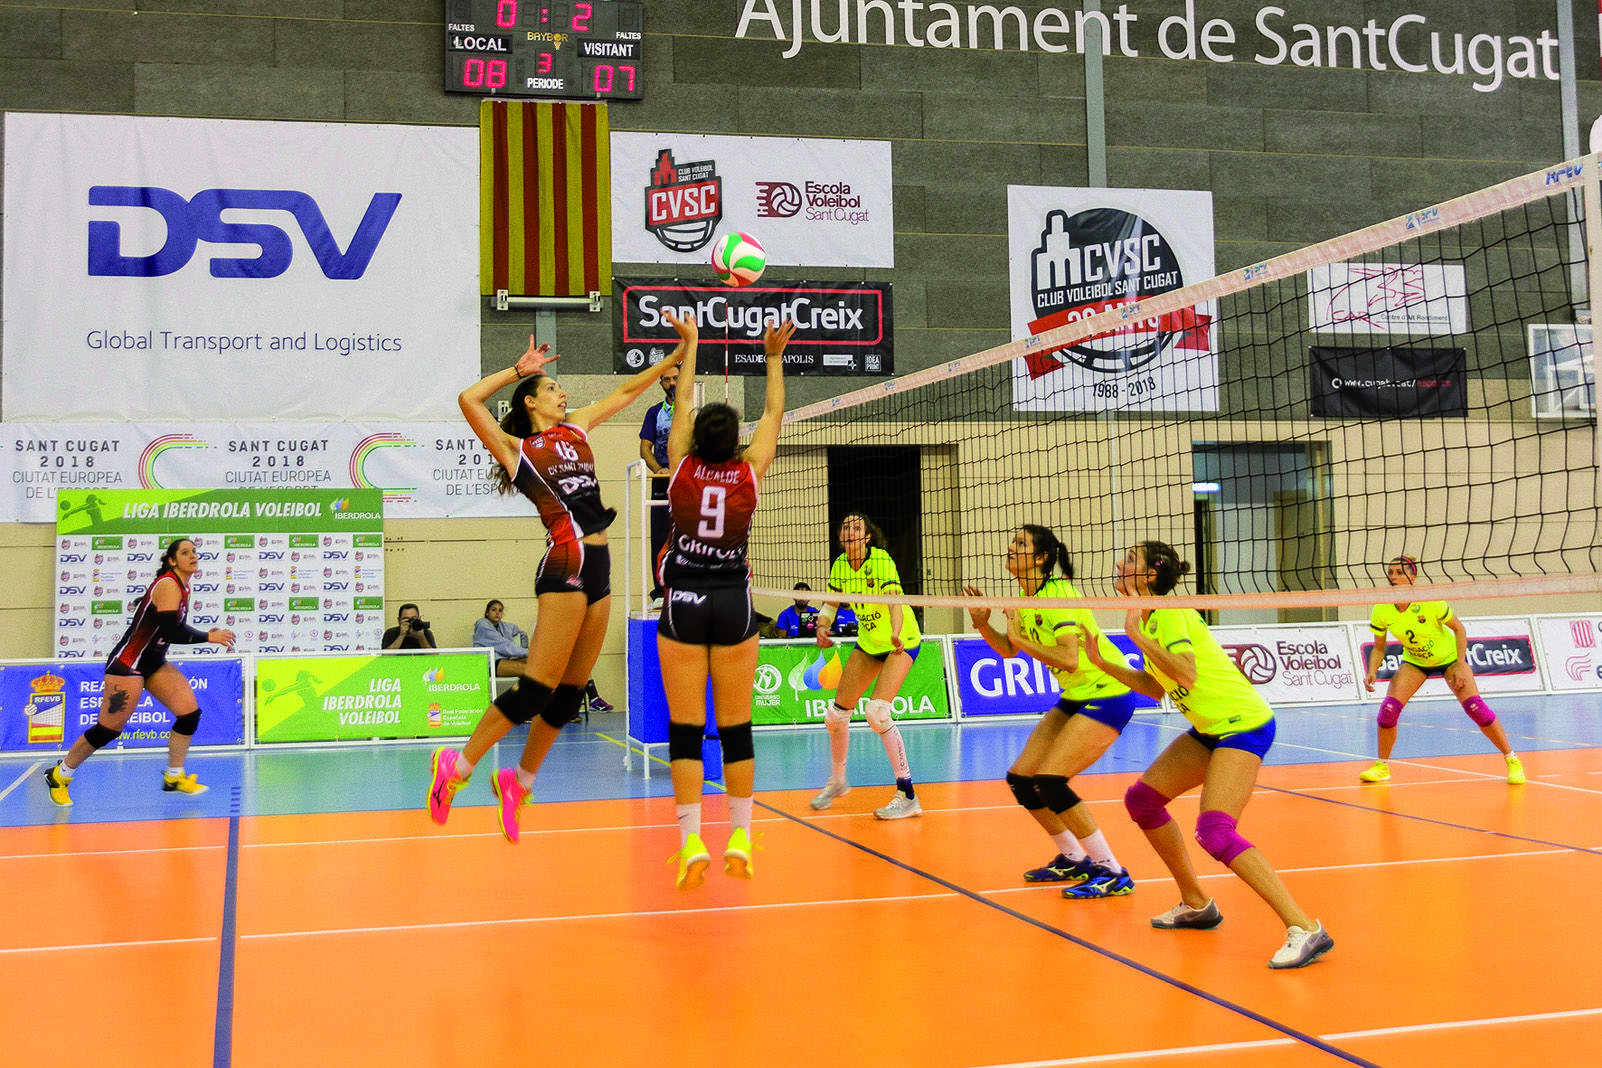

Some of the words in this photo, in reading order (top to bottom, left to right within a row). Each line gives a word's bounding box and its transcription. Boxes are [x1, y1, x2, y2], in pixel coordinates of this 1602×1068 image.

[496, 0, 518, 27] 0
[571, 3, 592, 31] 2
[448, 23, 475, 32] FALTES
[615, 31, 642, 40] FALTES
[455, 36, 507, 52] LOCAL
[583, 42, 634, 58] VISITANT
[734, 0, 1139, 59] Ajuntament
[1157, 0, 1236, 63] de
[1254, 5, 1560, 92] SantCugat
[537, 52, 553, 74] 3
[463, 58, 507, 88] 08
[594, 64, 636, 93] 07
[527, 77, 564, 90] PERIODE
[678, 168, 691, 176] CLUB
[678, 174, 691, 182] SANT
[692, 171, 709, 181] CUGAT
[804, 180, 851, 195] Escola
[651, 185, 716, 222] CVSC
[805, 194, 861, 208] Voleibol
[805, 208, 834, 221] Sant
[833, 208, 869, 225] Cugat
[88, 185, 403, 280] DSV
[1084, 234, 1161, 283] CVSC
[1037, 291, 1064, 309] CLUB
[1066, 284, 1114, 302] VOLEIBOL
[1114, 278, 1141, 296] SANT
[1143, 271, 1178, 291] CUGAT
[638, 295, 864, 337] SantCugatCreix
[86, 330, 153, 350] Global
[159, 331, 263, 355] Transport
[269, 331, 307, 351] and
[314, 332, 403, 357] Logistics
[1093, 383, 1119, 398] 1988
[1128, 377, 1157, 397] 2018
[15, 440, 59, 452] SANT
[65, 439, 121, 452] CUGAT
[228, 440, 270, 452] SANT
[277, 439, 329, 452] CUGAT
[435, 439, 477, 451] SANT
[39, 455, 95, 468] 2018
[252, 455, 306, 468] 2018
[458, 454, 495, 466] 201
[12, 471, 59, 484] CIUTAT
[60, 470, 123, 484] EUROPEA
[225, 471, 270, 483] CIUTAT
[271, 470, 332, 483] EUROPEA
[432, 469, 479, 481] CIUTAT
[693, 464, 741, 485] ALCALDE
[25, 486, 44, 499] DE
[445, 483, 462, 496] DE
[465, 483, 499, 496] L'ESP
[122, 503, 160, 519] LIGA
[162, 501, 252, 519] IBERDROLA
[255, 501, 323, 518] VOLEIBOL
[334, 512, 382, 520] IBERDROLA
[697, 485, 727, 539] 9
[672, 590, 708, 605] DSV
[1405, 629, 1418, 645] 2
[1275, 639, 1328, 656] Escola
[1279, 654, 1342, 671] Voleibol
[970, 653, 1141, 698] GRIS
[1282, 671, 1313, 686] Sant
[1313, 670, 1355, 690] Cugat
[80, 680, 106, 692] REA
[369, 678, 402, 693] LIGA
[428, 683, 481, 692] IBERDROLA
[34, 695, 62, 704] RFEVB
[322, 694, 402, 711] IBERDROLA
[755, 699, 782, 707] MUJER
[804, 695, 936, 718] IBDOLA
[79, 713, 99, 726] DE
[339, 710, 401, 726] VOLEIBOL
